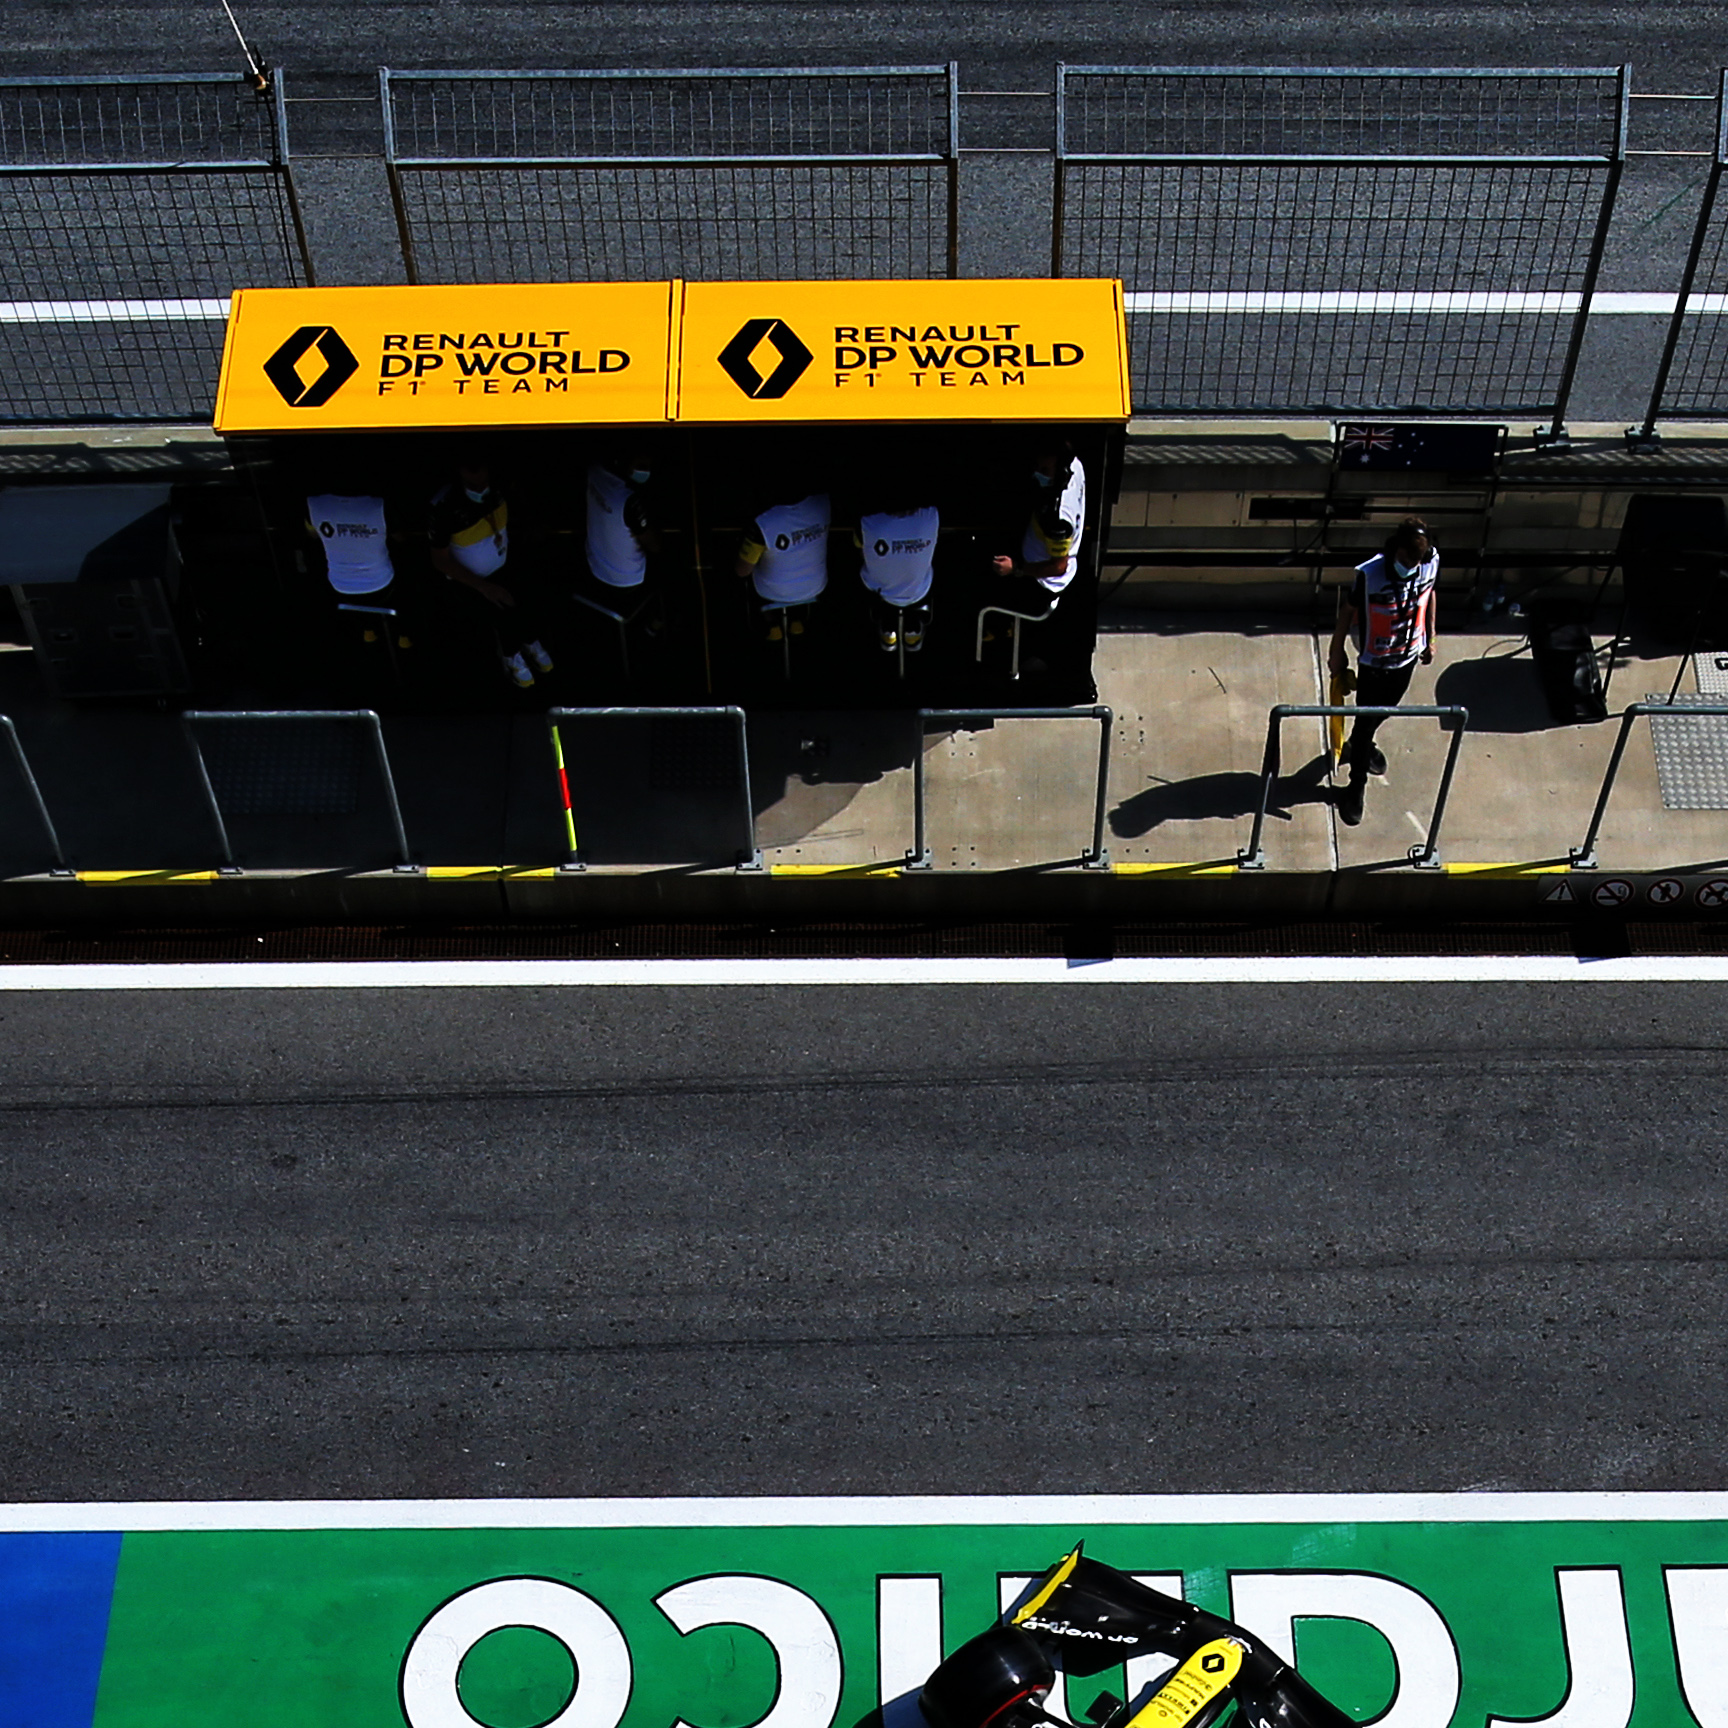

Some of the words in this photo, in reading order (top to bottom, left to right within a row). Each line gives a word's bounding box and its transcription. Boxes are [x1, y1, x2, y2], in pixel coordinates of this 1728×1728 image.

[383, 331, 570, 350] RENAULT
[834, 325, 1020, 343] RENAULT
[380, 353, 444, 378] DP
[455, 349, 631, 376] WORLD
[835, 346, 897, 370] DP
[908, 343, 1085, 369] WORLD
[453, 378, 569, 395] TEAM
[909, 371, 1026, 387] TEAM
